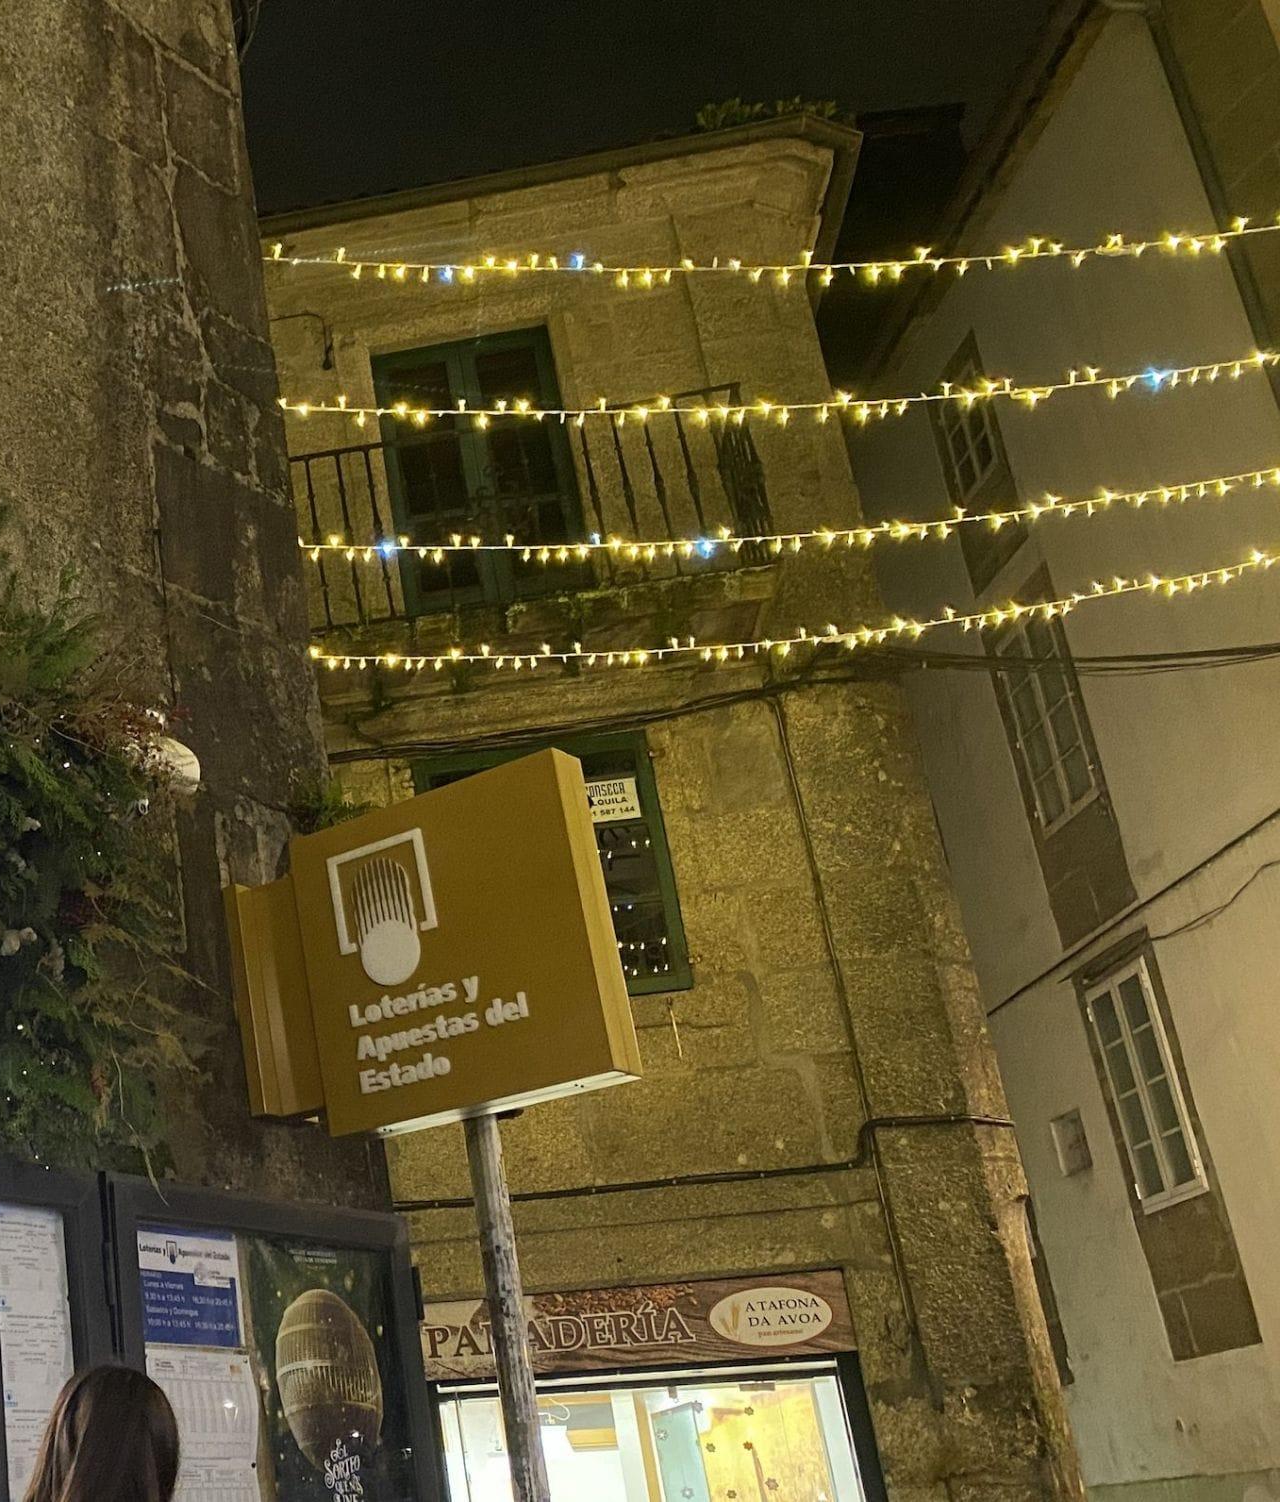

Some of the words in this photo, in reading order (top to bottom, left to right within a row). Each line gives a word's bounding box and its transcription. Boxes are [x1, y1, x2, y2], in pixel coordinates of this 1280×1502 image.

[585, 782, 626, 798] ONSECA
[349, 983, 458, 1028] Loterías
[461, 975, 479, 1004] y
[357, 1012, 480, 1062] Apuestas
[485, 991, 530, 1026] del
[359, 1053, 451, 1094] Estado
[745, 1301, 756, 1313] A
[757, 1297, 820, 1312] TAFONA
[748, 1316, 771, 1328] DA
[778, 1313, 822, 1326] AVOA
